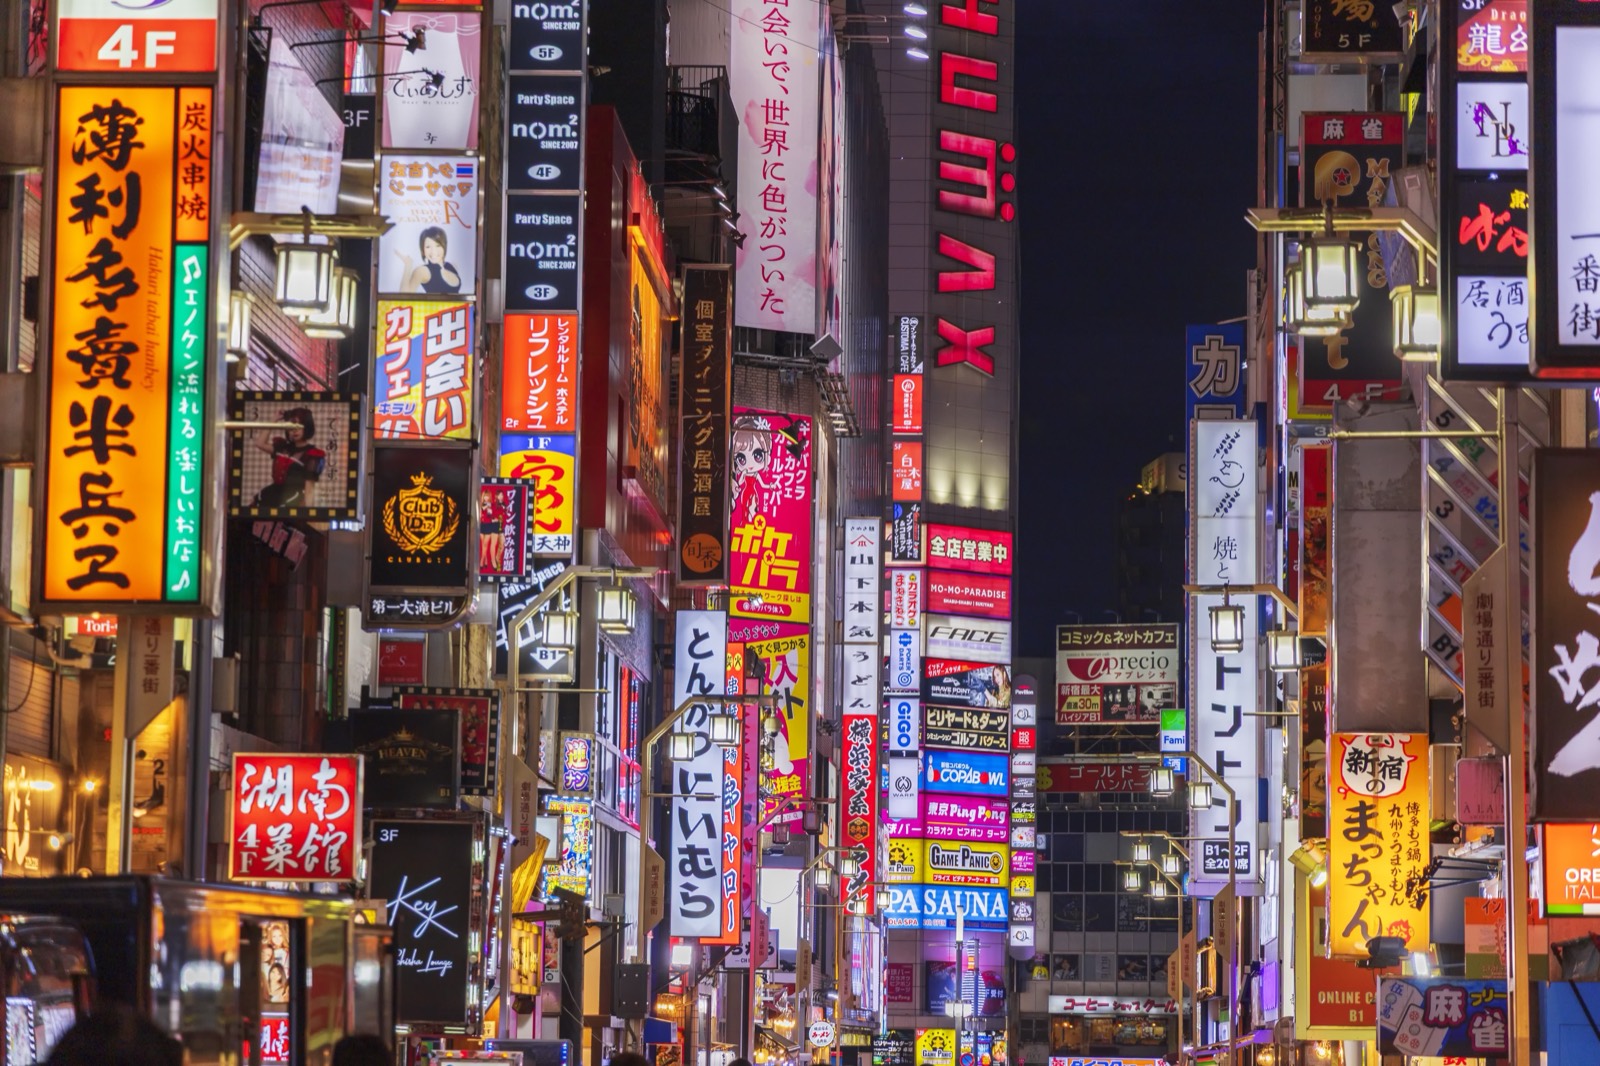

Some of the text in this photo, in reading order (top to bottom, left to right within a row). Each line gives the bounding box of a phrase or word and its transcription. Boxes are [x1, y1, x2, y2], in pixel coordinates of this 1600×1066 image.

[542, 22, 580, 30] SINCE 2007
[97, 24, 177, 68] 4F
[1338, 34, 1372, 48] 5F
[538, 47, 555, 59] 5F
[517, 94, 574, 107] Party Space
[343, 109, 370, 127] 3F
[424, 132, 438, 144] 3F
[1322, 119, 1383, 140] 麻雀
[540, 140, 578, 149] SINCE 2007
[177, 102, 209, 222] 炭火串焼
[536, 168, 553, 178] 4F
[515, 214, 572, 226] Party Space
[538, 261, 576, 270] SINCE 2007
[534, 287, 551, 298] 3F
[1461, 280, 1524, 308] 居酒
[386, 306, 413, 399] カフェ
[425, 305, 468, 437] 出会い
[526, 317, 550, 429] リフレッシュ
[555, 318, 570, 425] レンタルルーム ホステル
[1323, 383, 1384, 401] 4F
[378, 402, 416, 415] キラリ
[693, 299, 714, 517] 個室ダイニング居酒屋
[378, 420, 411, 439] 1F
[505, 417, 519, 428] 2F
[527, 437, 552, 449] 1F
[901, 453, 921, 490] 白木屋
[403, 497, 441, 514] Club
[502, 489, 516, 572] ワイン飲み放題
[536, 536, 571, 552] 天神
[930, 536, 1007, 564] 全店営業中
[531, 561, 565, 587] Space
[907, 582, 918, 618] カラオケ
[930, 584, 1006, 599] MO-MO-PARADISE
[372, 599, 459, 616] 第一大滝ビル
[849, 554, 875, 709] 山下本気うどん
[930, 625, 1008, 645] FACE
[1061, 630, 1175, 645] コミック&ネットカフェ
[539, 651, 557, 660] B1
[1476, 592, 1494, 708] 劇場通り一番街
[931, 685, 971, 695] BRAVE POINT
[1061, 685, 1100, 696] 新宿最大
[926, 709, 1007, 732] ビリヤード&ダーツ
[951, 732, 978, 746] ゴルフ
[1164, 735, 1185, 745] Fami
[379, 748, 428, 760] HEAVEN
[565, 738, 589, 770] 逆
[848, 718, 873, 816] 横浜家系
[1345, 747, 1405, 781] 新宿
[678, 628, 718, 919] とんかつにいむら
[1366, 778, 1386, 794] の
[928, 802, 1006, 824] 東京 Ping Pong
[380, 829, 399, 841] 3F
[926, 826, 953, 836] カラオケ
[987, 828, 1007, 838] ダーツ
[1405, 801, 1422, 863] 博多もつ鍋
[238, 824, 261, 874] 4F
[931, 843, 990, 869] GAME PANIC
[1388, 803, 1405, 907] 九州のうまかもん
[1341, 800, 1387, 943] まっちゃん
[1565, 884, 1600, 899] ITAL
[386, 875, 459, 938] Key
[924, 888, 1008, 918] SAUNA
[1063, 998, 1177, 1013] コーヒー ショップ クール
[1318, 990, 1361, 1004] ONLINE
[1470, 988, 1507, 1007] フリー
[1349, 1009, 1364, 1022] B1
[1428, 987, 1506, 1050] 麻雀
